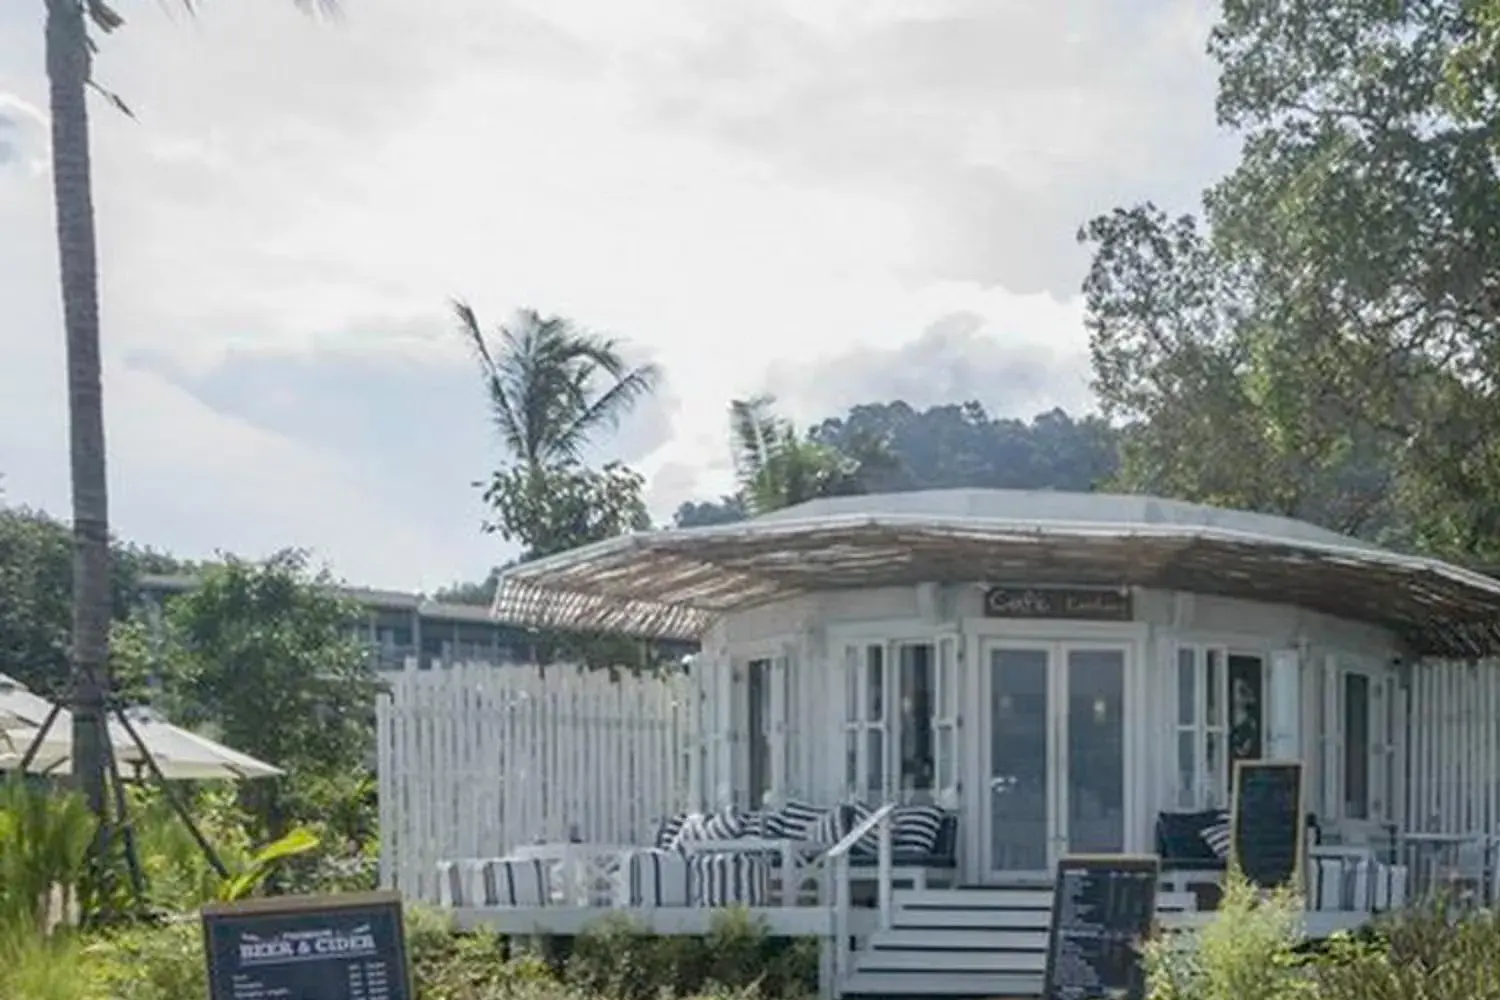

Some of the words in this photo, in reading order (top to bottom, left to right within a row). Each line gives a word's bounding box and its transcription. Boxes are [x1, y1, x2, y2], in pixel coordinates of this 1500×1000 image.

[239, 940, 295, 958] BEER
[297, 940, 311, 955] &
[314, 934, 376, 953] CIDER
